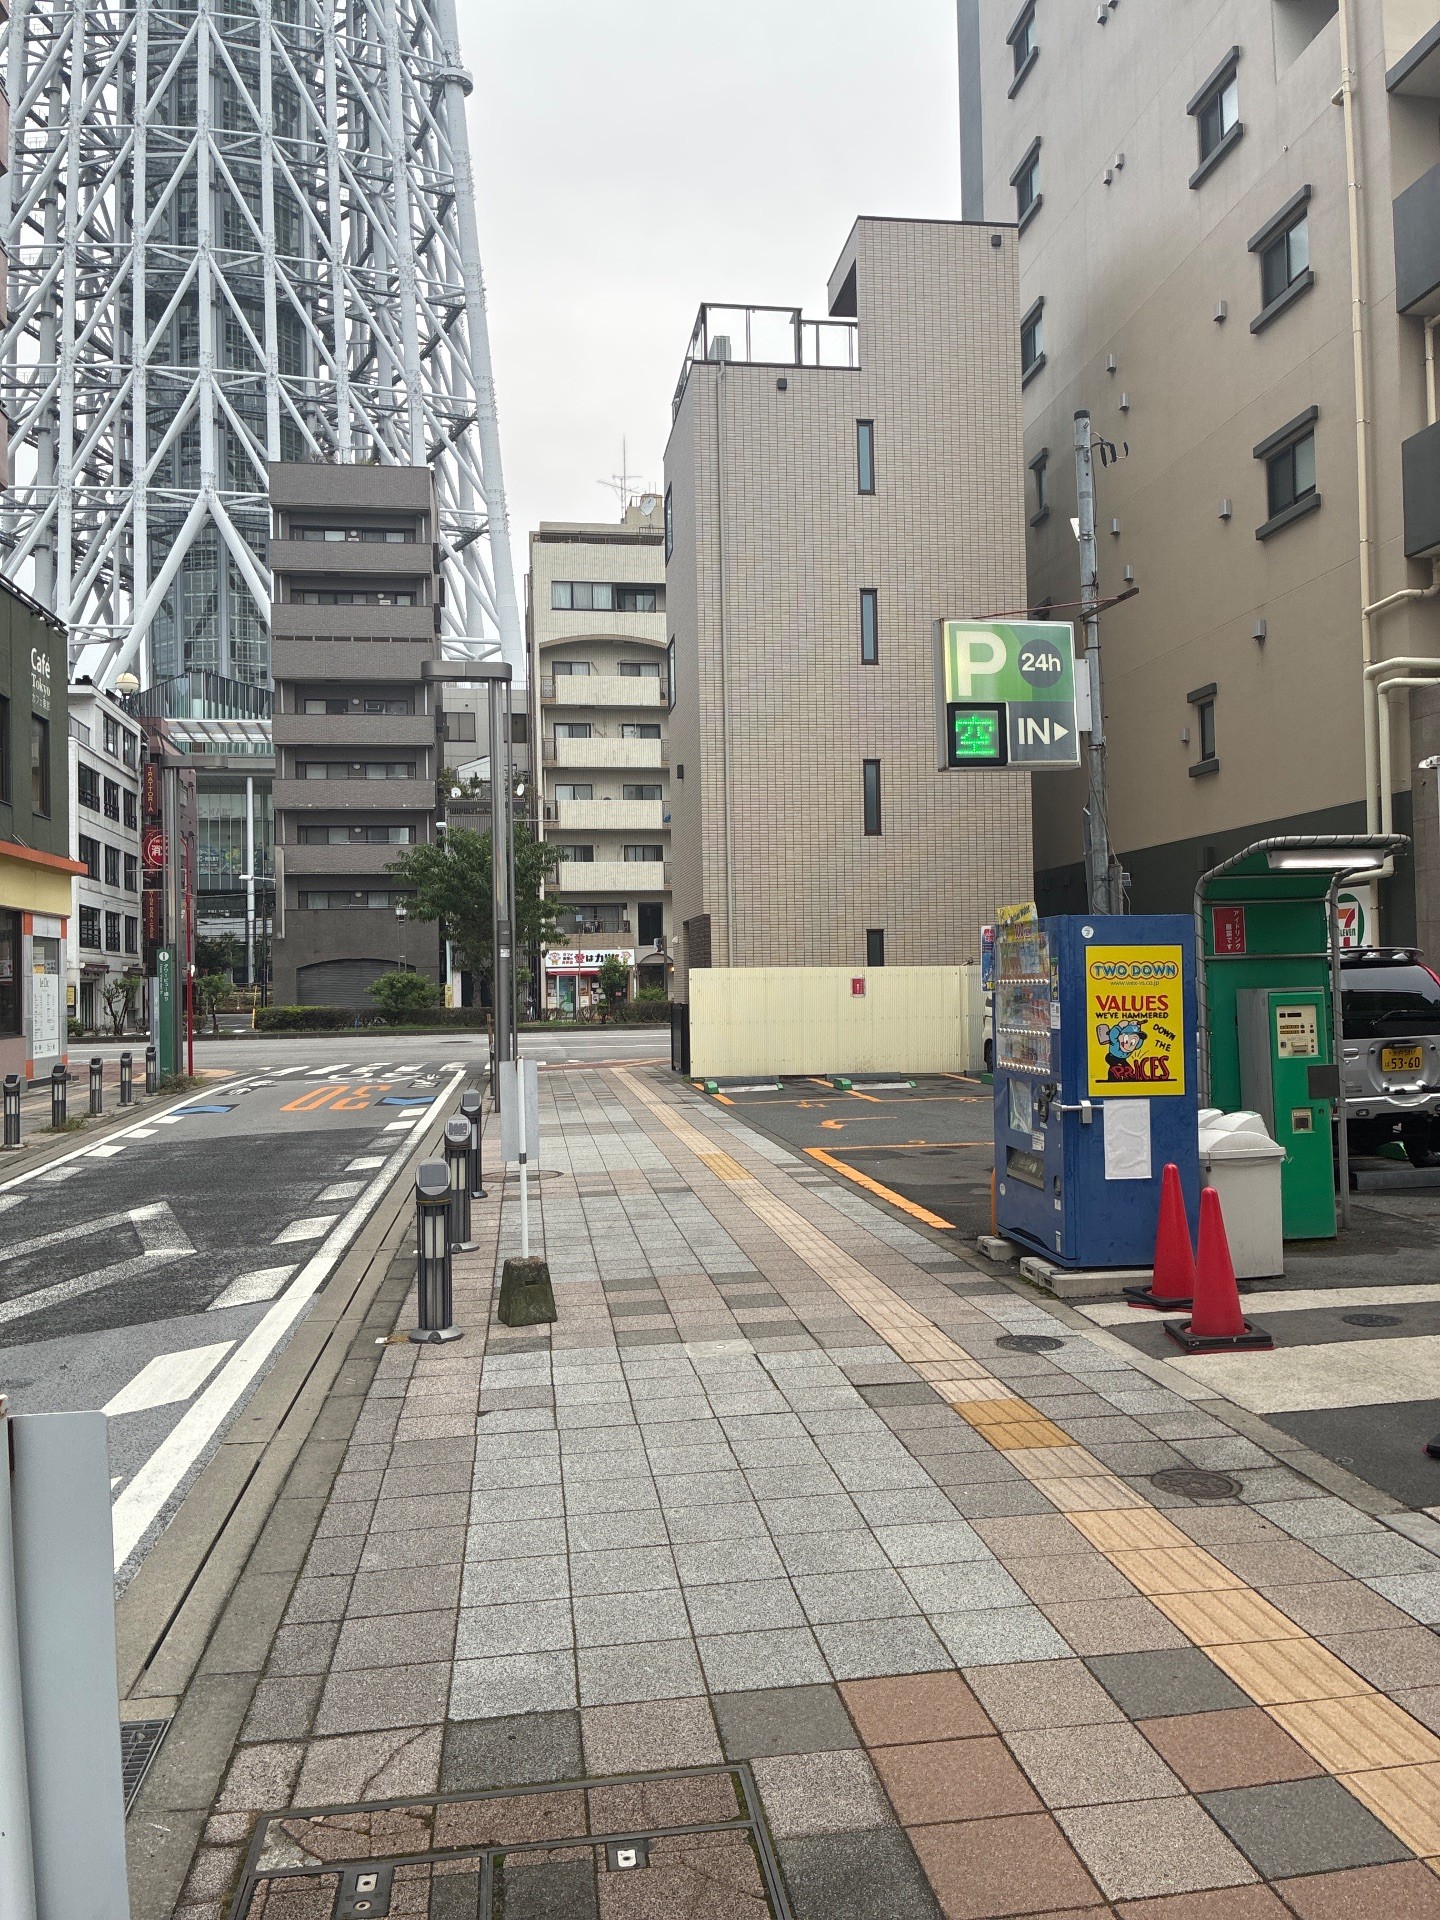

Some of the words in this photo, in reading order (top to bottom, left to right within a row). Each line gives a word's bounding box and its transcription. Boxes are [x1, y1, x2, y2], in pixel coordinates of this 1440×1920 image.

[31, 647, 51, 679] Café
[956, 631, 1006, 696] P
[1021, 652, 1062, 672] 24h
[31, 672, 51, 698] Tokyo
[956, 716, 994, 755] 空
[1018, 717, 1050, 745] IN
[1233, 910, 1241, 950] アイドリング
[1094, 965, 1128, 976] TWO
[1131, 965, 1176, 976] DOWN
[1095, 994, 1169, 1012] VALUES
[1095, 1011, 1119, 1019] WE'VE
[1122, 1011, 1169, 1019] HAMMERED
[1152, 1023, 1176, 1041] DOWN
[1155, 1039, 1172, 1052] THE
[1110, 1055, 1170, 1081] PRICES
[1391, 1056, 1421, 1069] 53-60
[279, 1085, 393, 1111] 30
